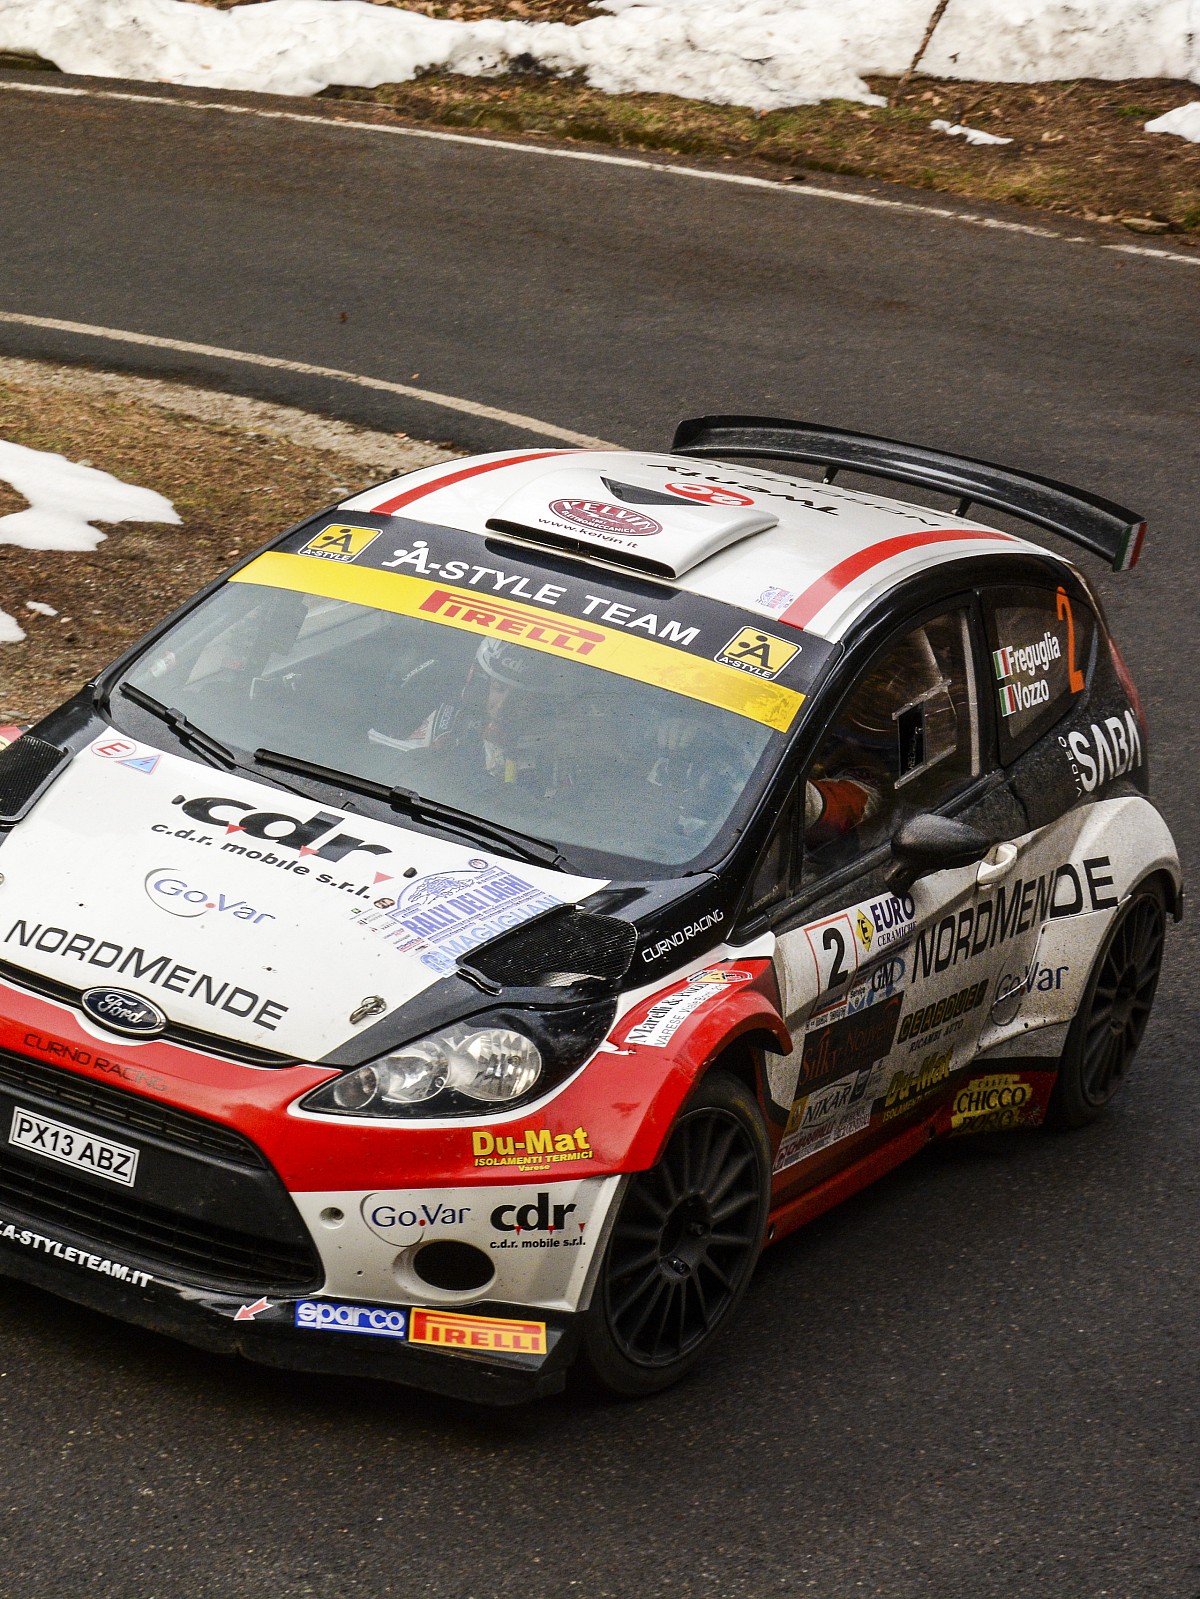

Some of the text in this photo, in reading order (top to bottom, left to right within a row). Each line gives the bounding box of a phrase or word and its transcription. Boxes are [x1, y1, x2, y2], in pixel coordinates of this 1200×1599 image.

[562, 501, 656, 530] KELVIN
[302, 547, 351, 562] A-STYLE
[419, 590, 606, 656] PIRELLI
[581, 594, 700, 646] TEAM
[1056, 586, 1085, 694] 2
[719, 655, 773, 679] A-STYLE
[1007, 631, 1061, 677] Freguglia
[1013, 679, 1049, 712] Vozzo
[182, 796, 392, 863] cdr
[151, 824, 371, 899] c.d.r. mobile s.r.l.
[400, 900, 456, 938] RALLY
[448, 887, 491, 918] DEI
[479, 873, 535, 907] LAGHI
[870, 892, 916, 933] EURO
[912, 856, 1119, 983] NORDMENDE
[642, 909, 724, 963] CURNO RACING
[3, 919, 289, 1031] NORDMENDE
[822, 927, 849, 991] 2
[98, 992, 143, 1025] Ford
[629, 998, 672, 1045] Marelli
[654, 1009, 687, 1048] VARESE
[24, 1033, 167, 1092] CURNO RACING
[957, 1086, 1027, 1114] CHICCO
[17, 1117, 131, 1177] PX13 ABZ
[471, 1126, 590, 1157] Du-Mat
[474, 1151, 593, 1167] ISOLAMENTI TERMICI
[490, 1192, 576, 1232] cdr
[490, 1236, 586, 1249] c.d.r. mobile s.r.l.
[298, 1302, 405, 1331] sparco
[411, 1310, 541, 1352] PIRELLI
